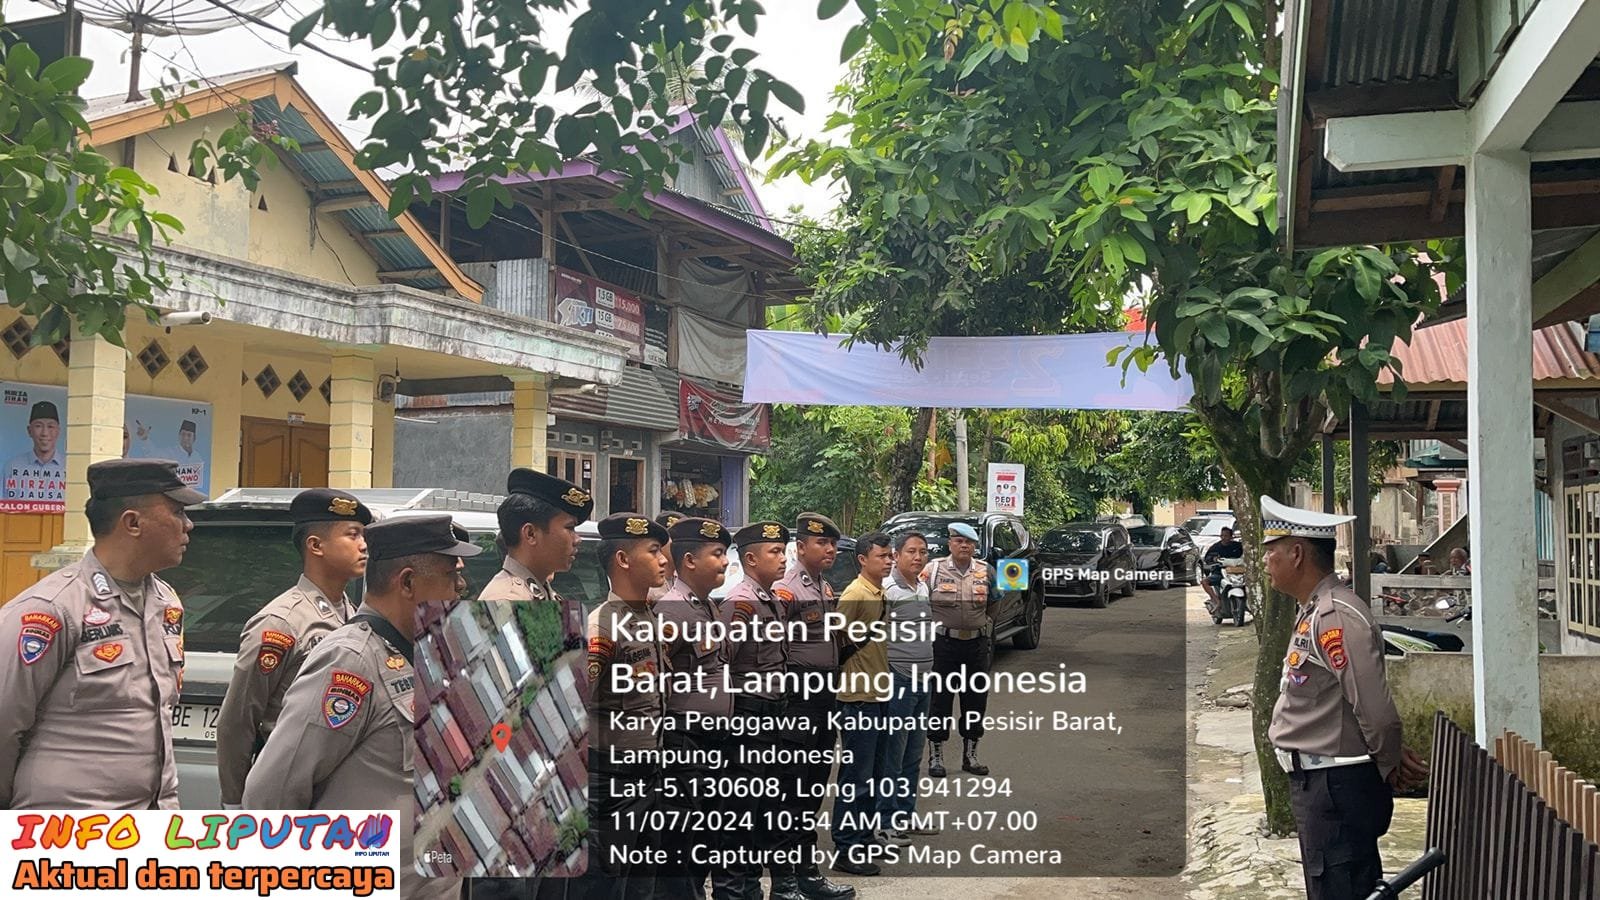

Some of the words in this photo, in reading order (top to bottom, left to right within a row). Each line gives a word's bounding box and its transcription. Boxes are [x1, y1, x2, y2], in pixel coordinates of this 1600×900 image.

[7, 479, 66, 490] MIRZAN
[8, 490, 63, 499] DJAUSA
[32, 503, 66, 511] GUBERN
[172, 705, 192, 727] BE
[203, 706, 220, 729] 12
